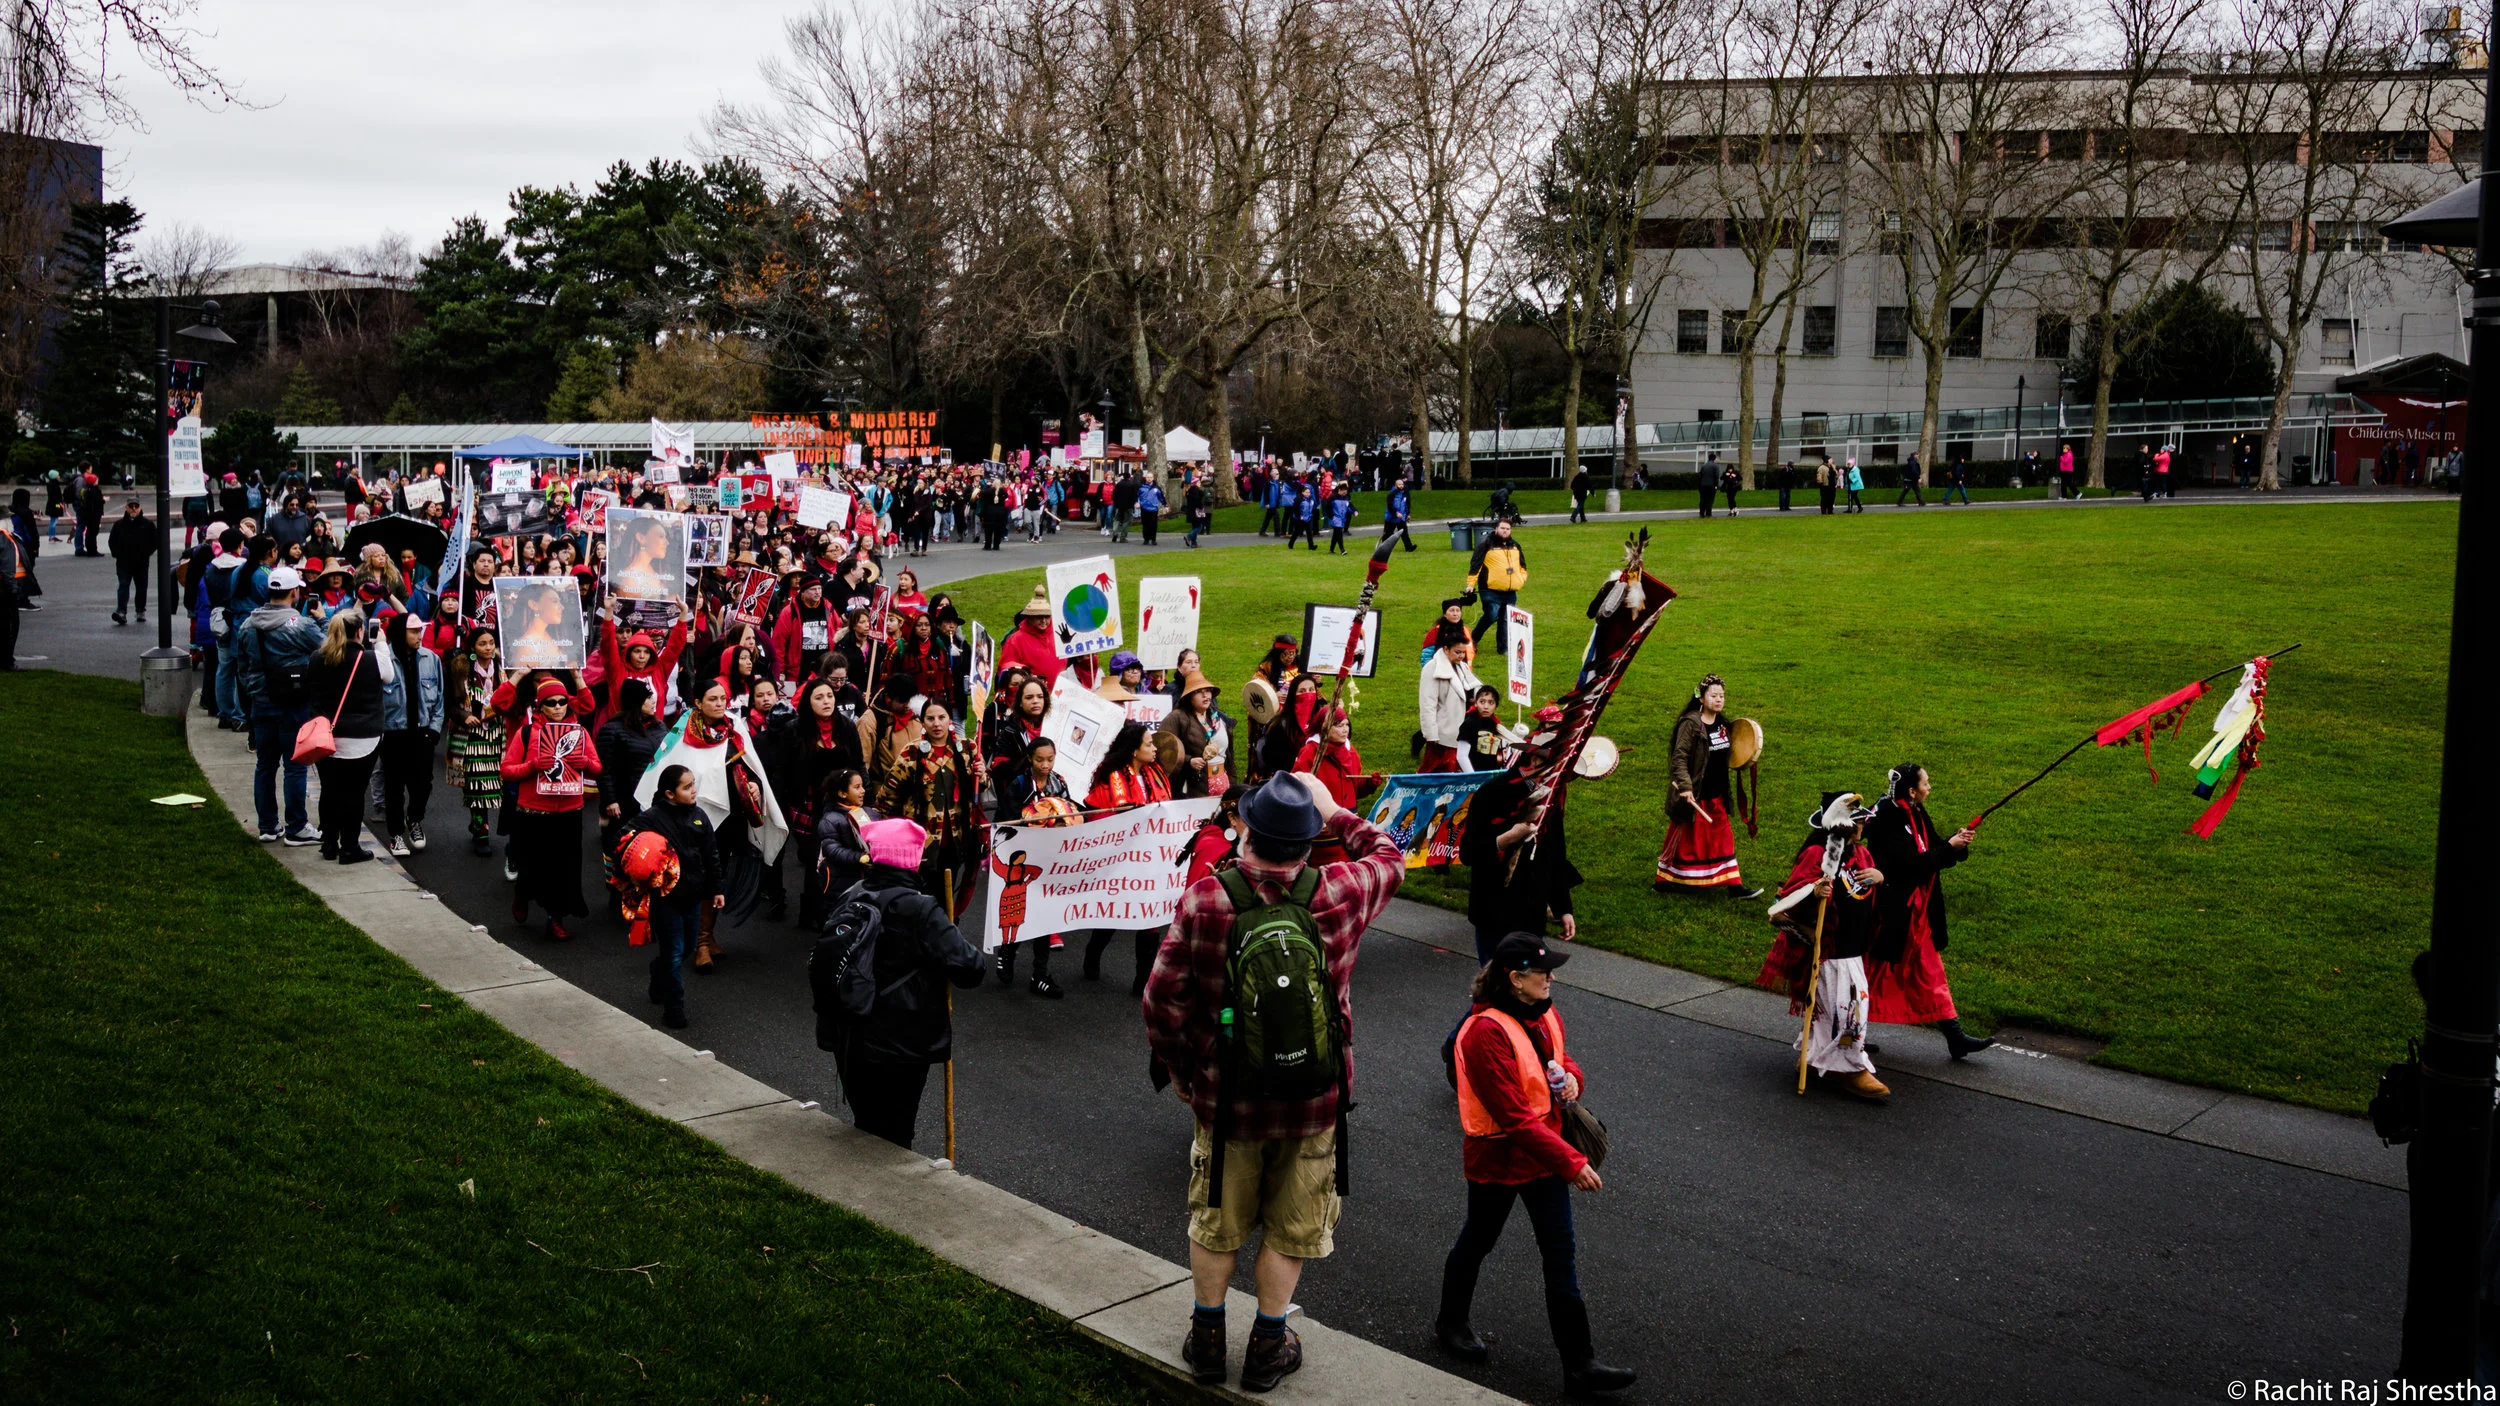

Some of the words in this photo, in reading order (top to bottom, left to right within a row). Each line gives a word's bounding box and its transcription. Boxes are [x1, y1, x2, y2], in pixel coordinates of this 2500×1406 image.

[751, 413, 820, 428] MISSING
[830, 412, 840, 428] &
[850, 411, 936, 428] MURDERED
[764, 430, 851, 446] INDIGENOUS
[865, 428, 930, 446] WOMEN
[2348, 426, 2404, 440] Children's
[1064, 636, 1115, 655] earth
[1139, 705, 1160, 720] are
[1058, 829, 1126, 854] Missing
[1129, 822, 1142, 838] &
[1145, 814, 1201, 835] Murde
[1428, 842, 1460, 859] Wome
[1048, 849, 1152, 876] Indigenous
[1159, 844, 1183, 863] Wo
[1041, 876, 1156, 900] Washington
[1166, 872, 1188, 890] Ma
[1063, 898, 1178, 925] (M.M.I.W.W
